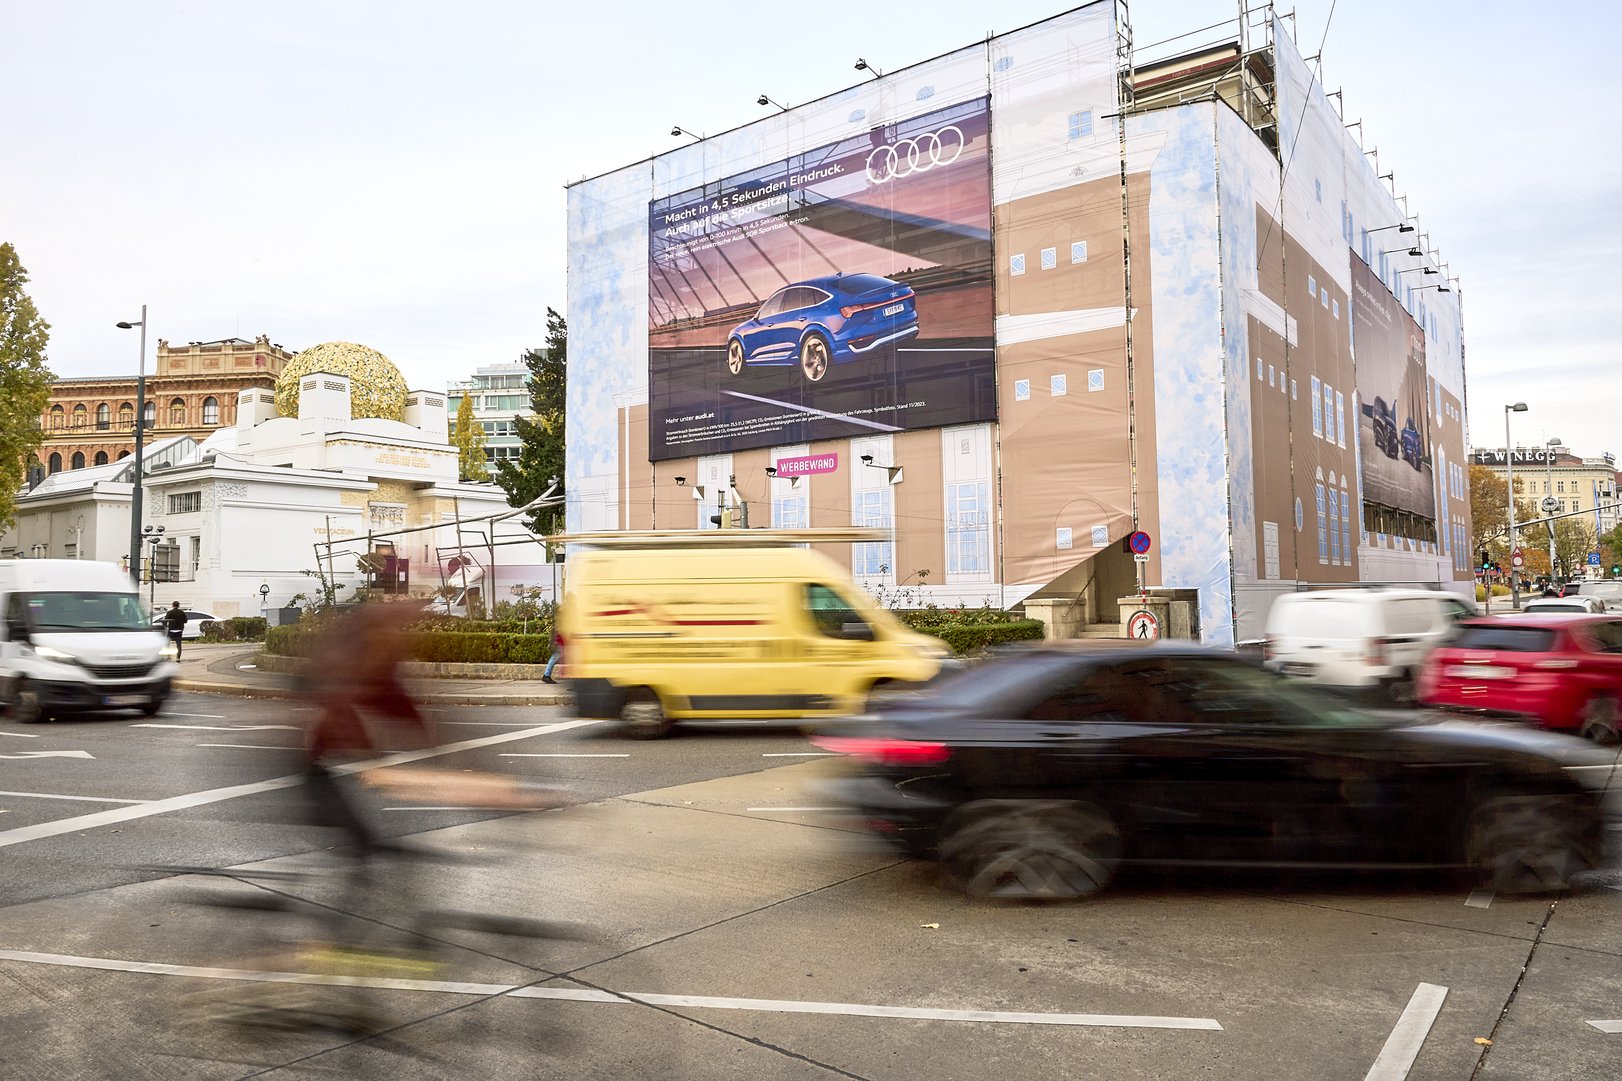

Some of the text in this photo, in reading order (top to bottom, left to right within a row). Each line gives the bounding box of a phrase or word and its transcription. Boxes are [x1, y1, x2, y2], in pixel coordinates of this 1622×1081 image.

[665, 163, 845, 224] Macht in 4,5 Sekunden Eindruck.
[665, 195, 791, 237] Auch auf die Sportsitze.
[732, 233, 745, 242] Audi
[759, 221, 788, 234] Sportback
[695, 412, 715, 420] audi.at
[1494, 451, 1556, 461] WNEGG
[780, 458, 834, 473] WERBEWAND
